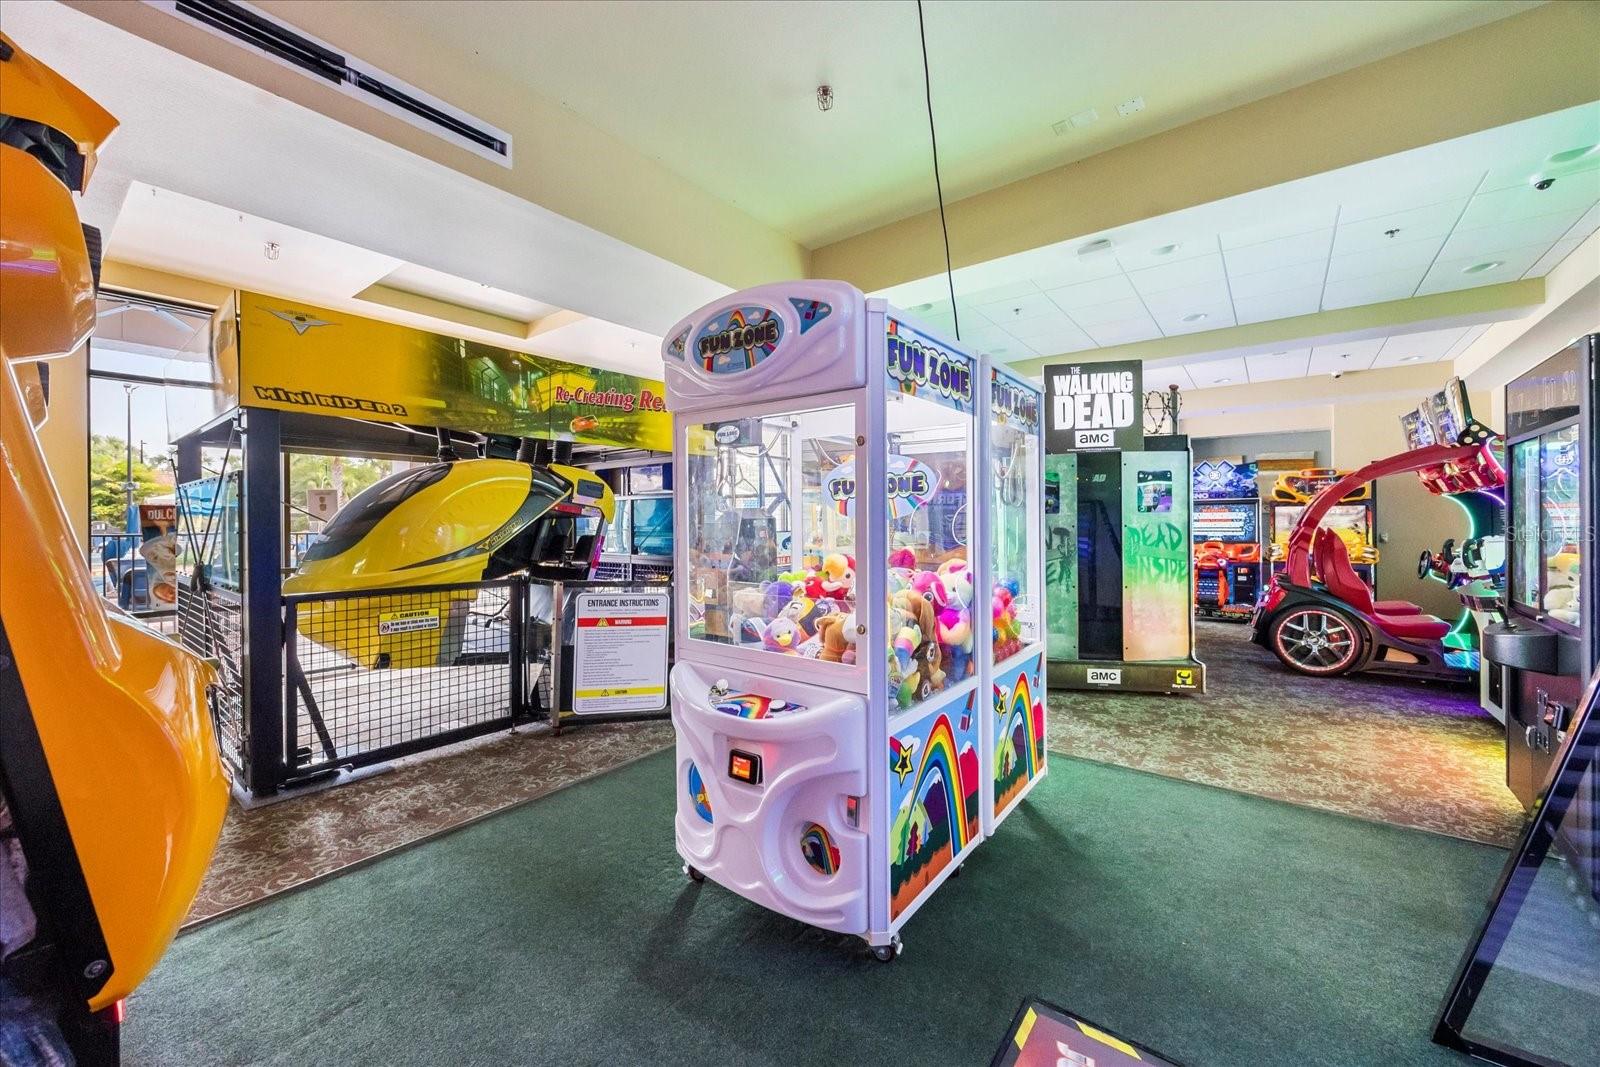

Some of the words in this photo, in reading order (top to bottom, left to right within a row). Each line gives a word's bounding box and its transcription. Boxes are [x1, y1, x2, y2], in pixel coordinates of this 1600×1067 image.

[700, 332, 732, 357] FUN
[734, 320, 779, 349] ZONE
[887, 337, 926, 379] FUN
[929, 355, 971, 397] ZONE
[1070, 366, 1081, 375] THE
[1053, 371, 1134, 396] WALKING
[253, 385, 317, 406] MINI
[315, 394, 393, 415] RIDER
[393, 404, 408, 416] 2
[555, 385, 637, 412] Re-Creating
[991, 382, 1012, 412] FUN
[1013, 391, 1038, 424] ZONE
[1053, 392, 1135, 431] DEAD
[832, 479, 856, 496] FU
[887, 475, 925, 494] ONE
[1126, 522, 1183, 551] DEAD
[400, 611, 430, 619] CAUTION
[587, 599, 618, 607] ENTRANCE
[619, 598, 659, 607] INSTRUCTIONS
